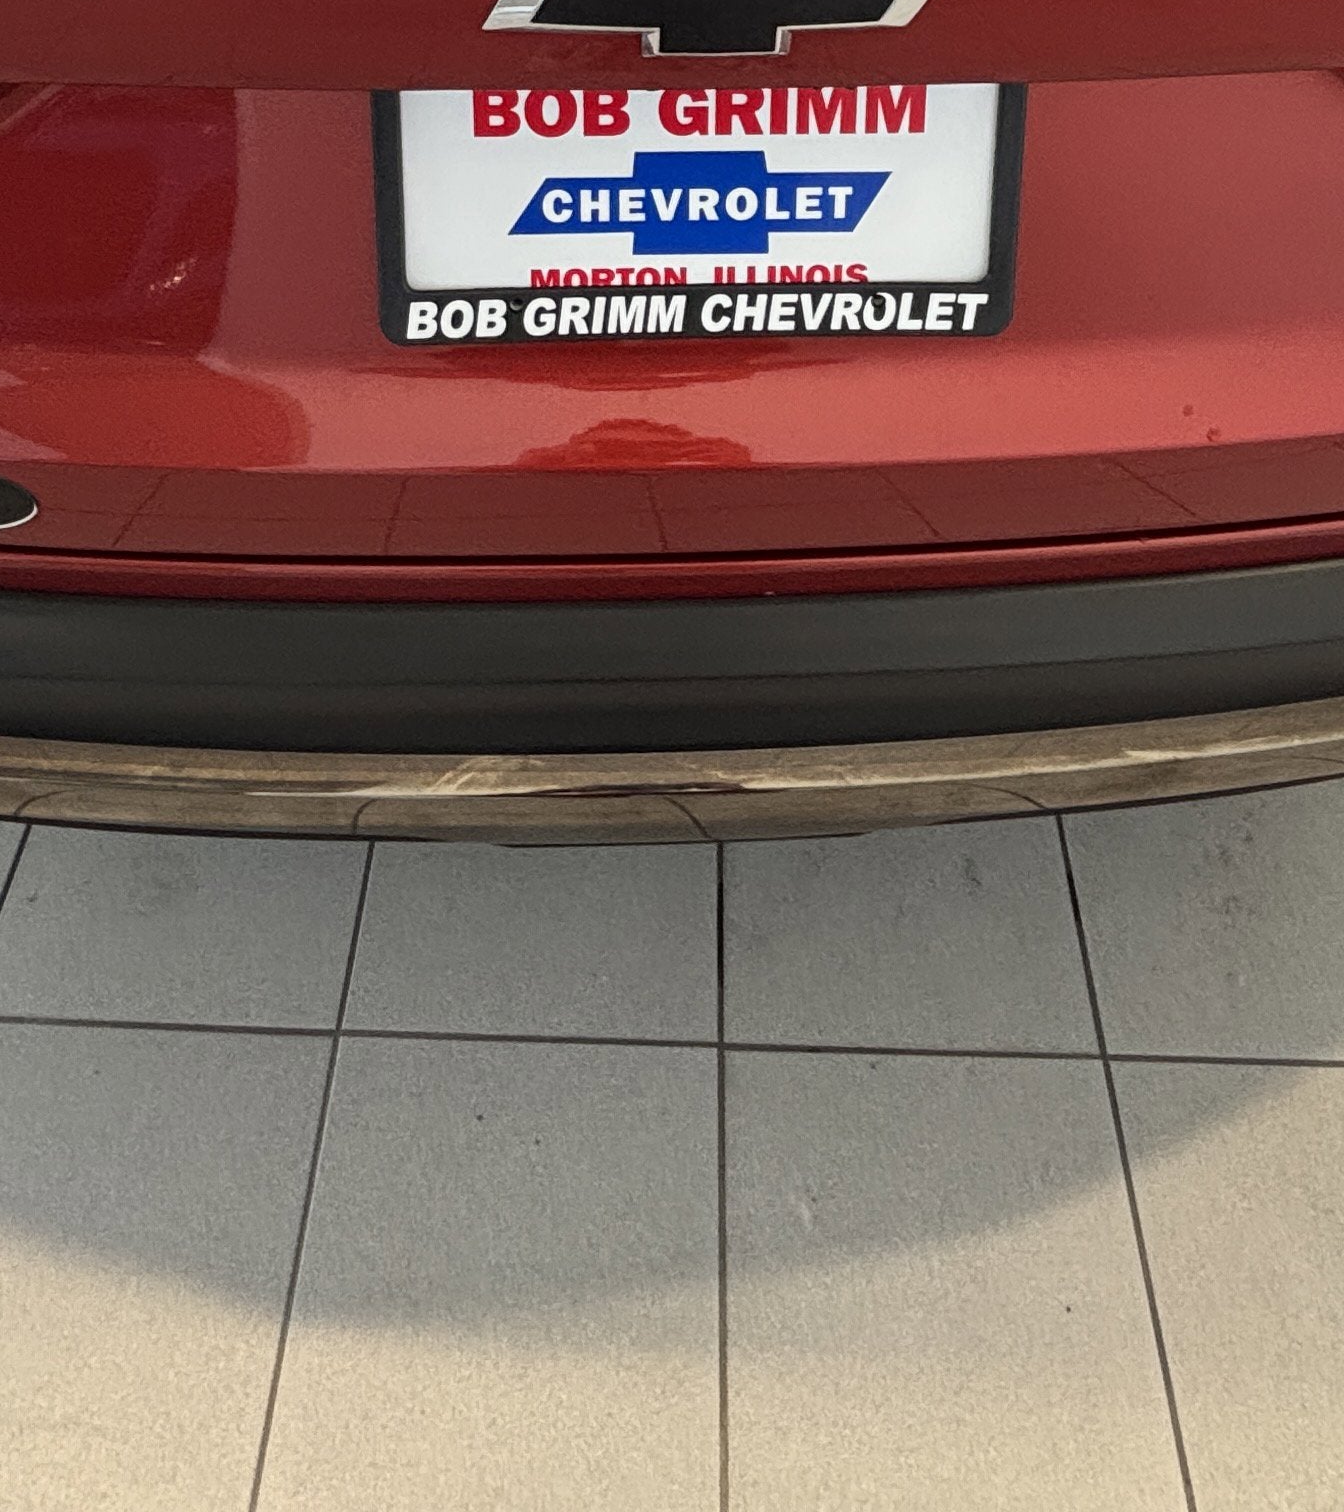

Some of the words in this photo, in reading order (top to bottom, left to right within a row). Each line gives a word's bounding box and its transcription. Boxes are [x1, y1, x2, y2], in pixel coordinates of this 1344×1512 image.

[473, 87, 630, 137] BOB
[658, 84, 926, 136] GRIMM
[541, 185, 854, 224] CHEVROLET
[529, 266, 688, 288] MORTON
[405, 296, 508, 340] BOB
[522, 294, 686, 337] GRIMM
[700, 292, 989, 335] CHEVROLET
